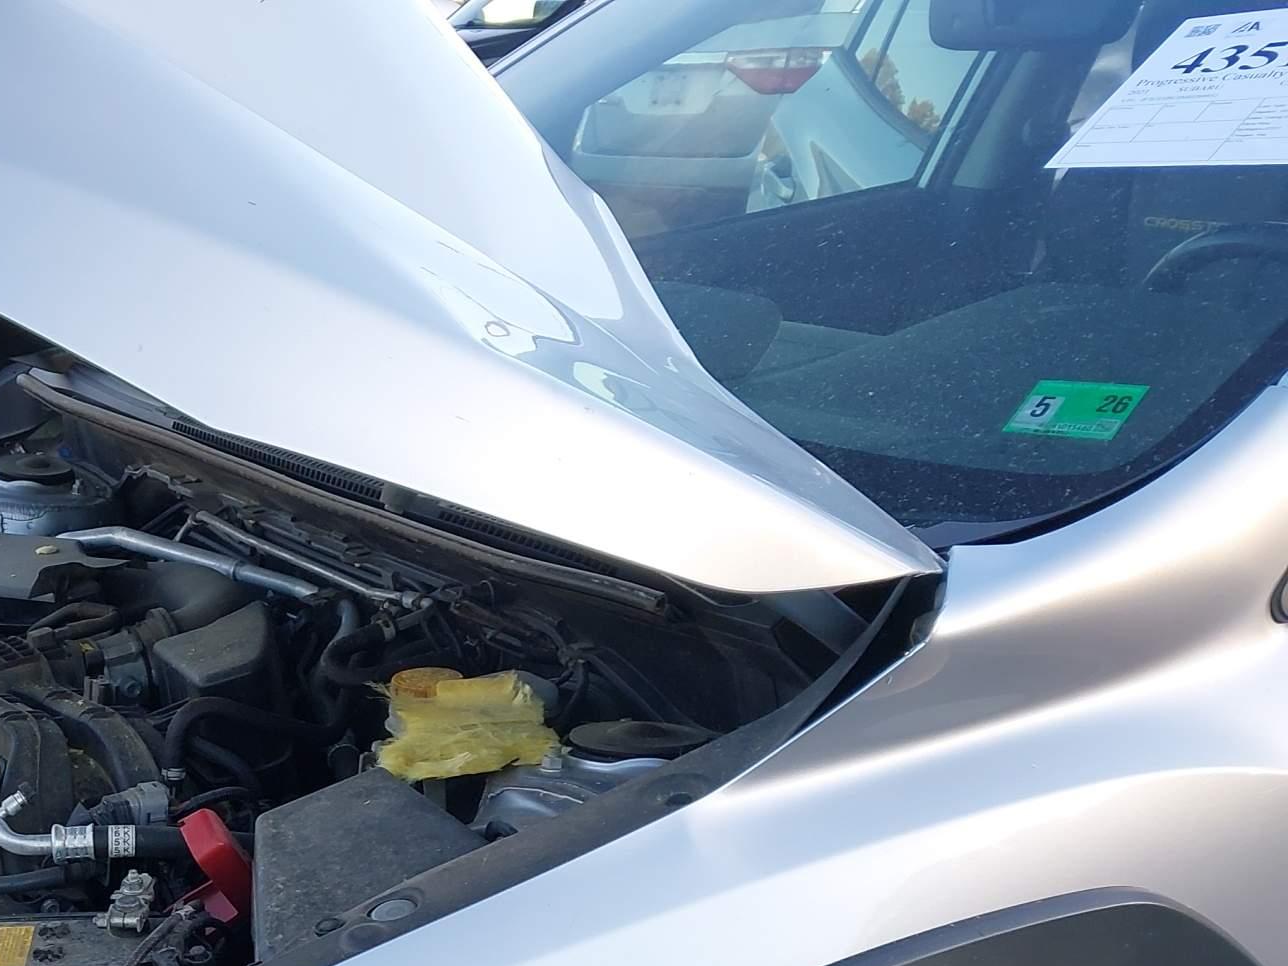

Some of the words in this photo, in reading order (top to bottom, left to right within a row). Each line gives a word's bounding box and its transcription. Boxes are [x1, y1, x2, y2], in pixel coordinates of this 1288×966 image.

[1171, 41, 1288, 74] 435
[1136, 74, 1218, 88] Progressive
[1222, 69, 1284, 81] Casualty
[1030, 396, 1057, 418] 5
[1096, 394, 1132, 414] 26
